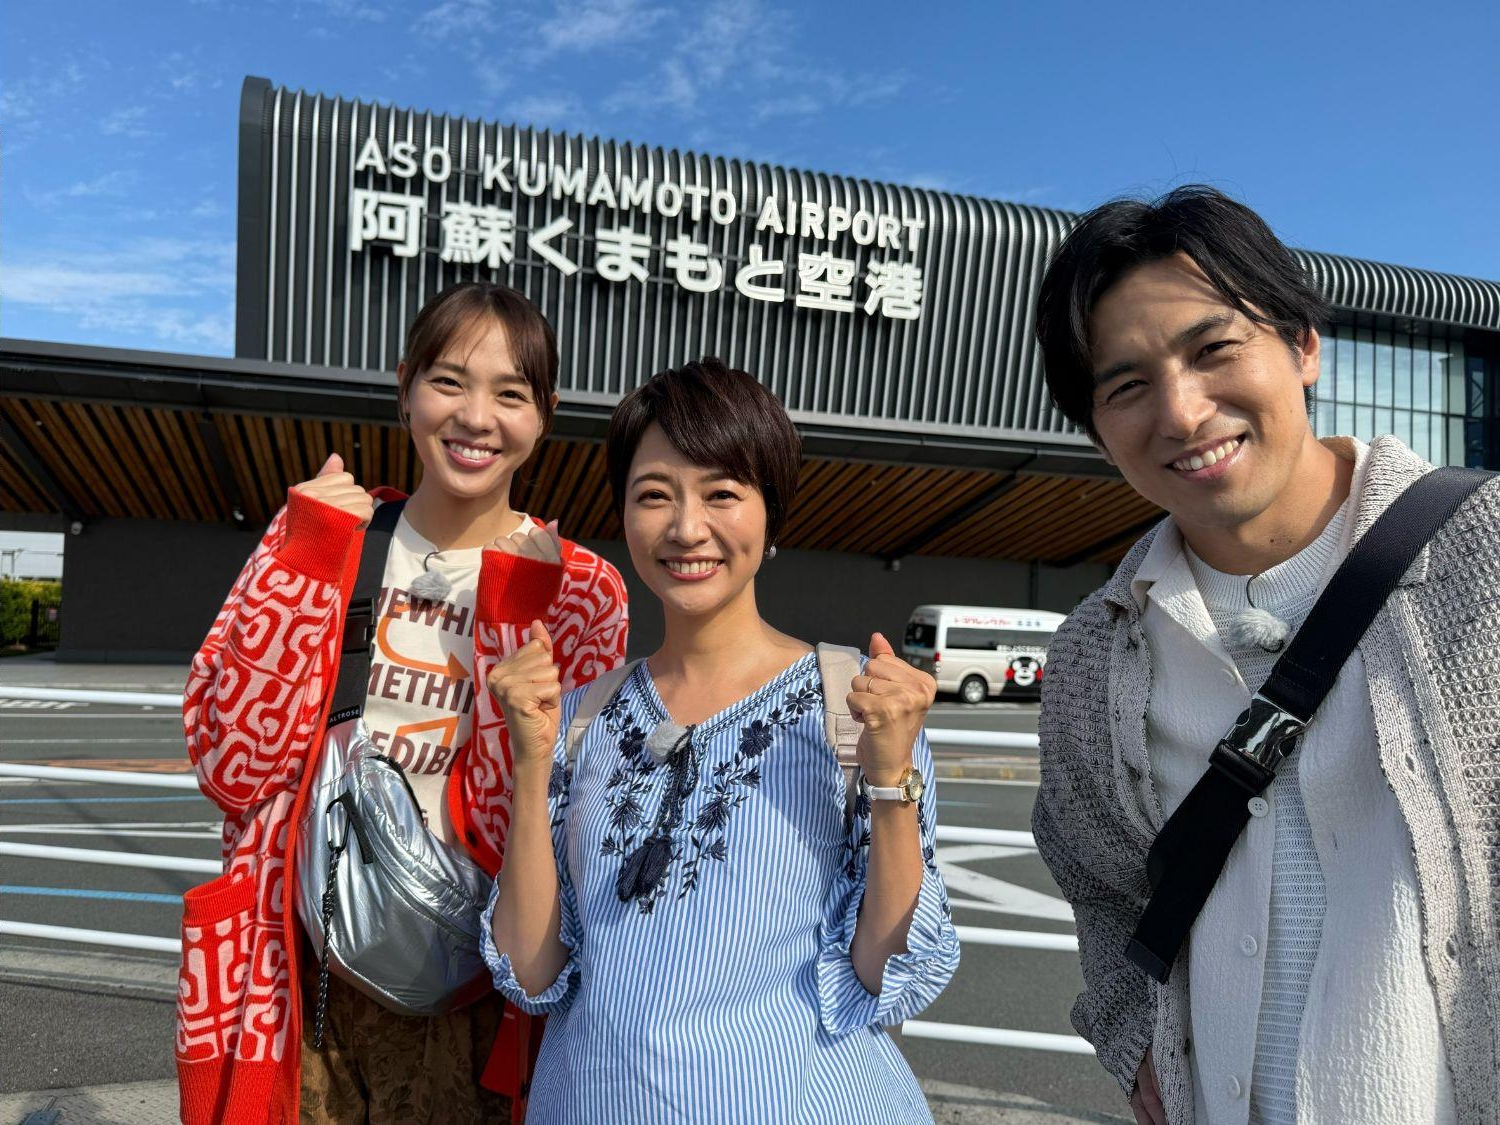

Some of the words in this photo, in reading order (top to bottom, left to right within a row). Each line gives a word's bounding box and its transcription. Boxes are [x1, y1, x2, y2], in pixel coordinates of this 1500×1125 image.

[350, 188, 923, 320] 阿蘇くまもと空港
[355, 137, 451, 183] ASO
[483, 154, 736, 225] KUMAMOTO
[756, 196, 925, 251] AIRPORT
